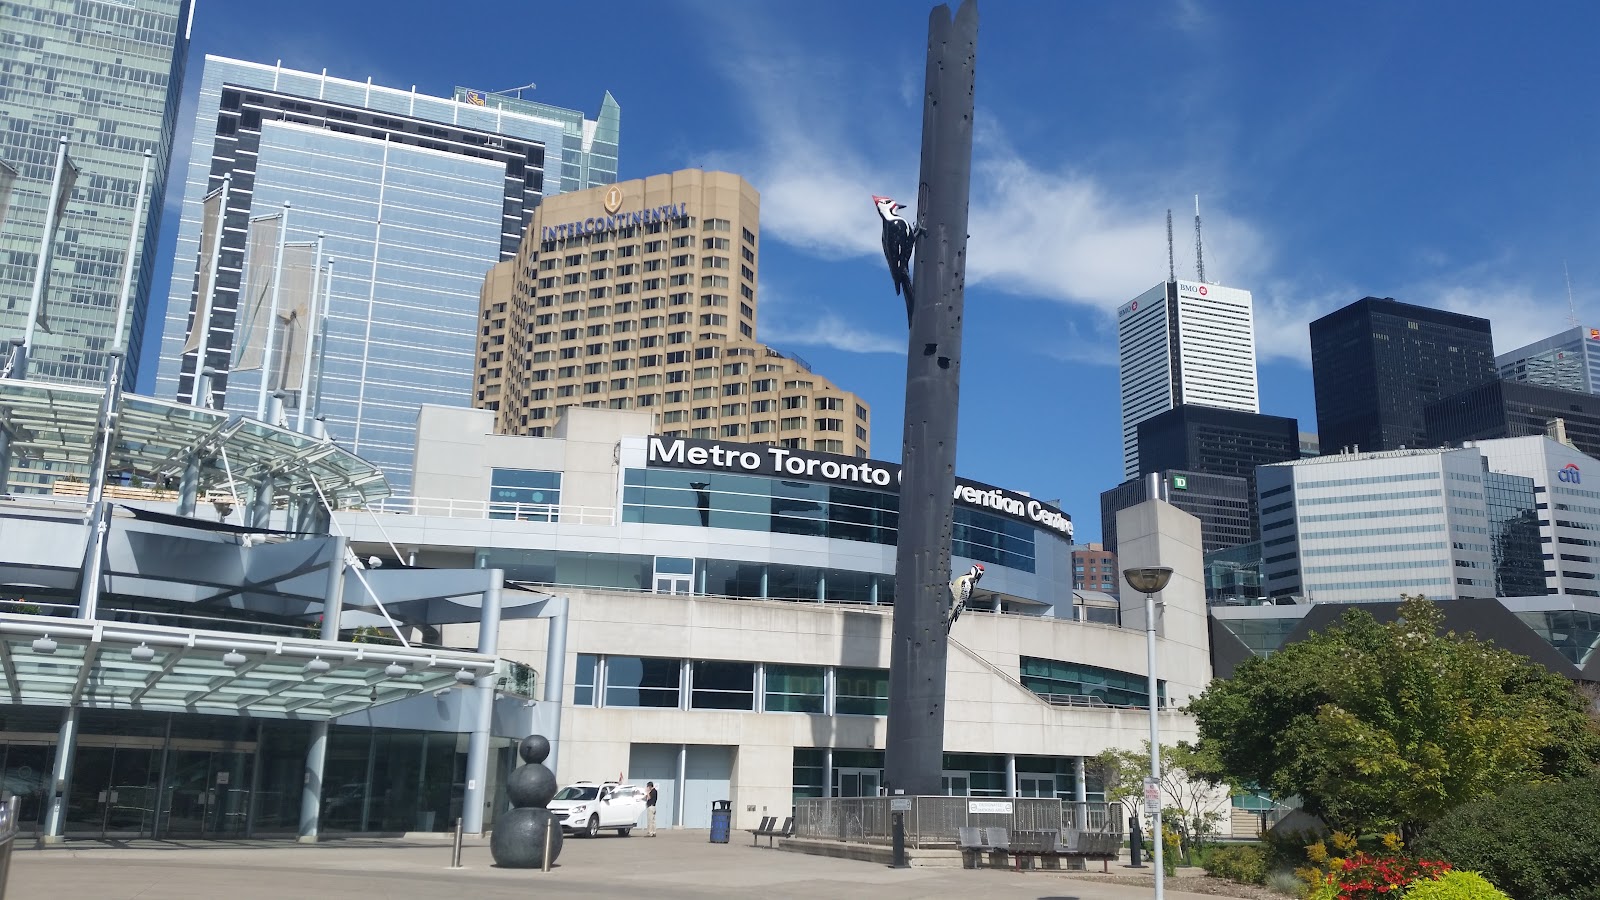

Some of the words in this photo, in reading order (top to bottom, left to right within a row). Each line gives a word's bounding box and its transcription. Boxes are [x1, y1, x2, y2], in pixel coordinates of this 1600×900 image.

[542, 202, 688, 242] INTERCONTINENTAL
[1180, 284, 1198, 293] BMO
[1119, 306, 1131, 317] BMO
[1175, 478, 1186, 487] TD
[1558, 466, 1581, 485] citi
[649, 438, 761, 470] Metro
[768, 448, 891, 486] Toronto
[1027, 500, 1075, 536] Centre
